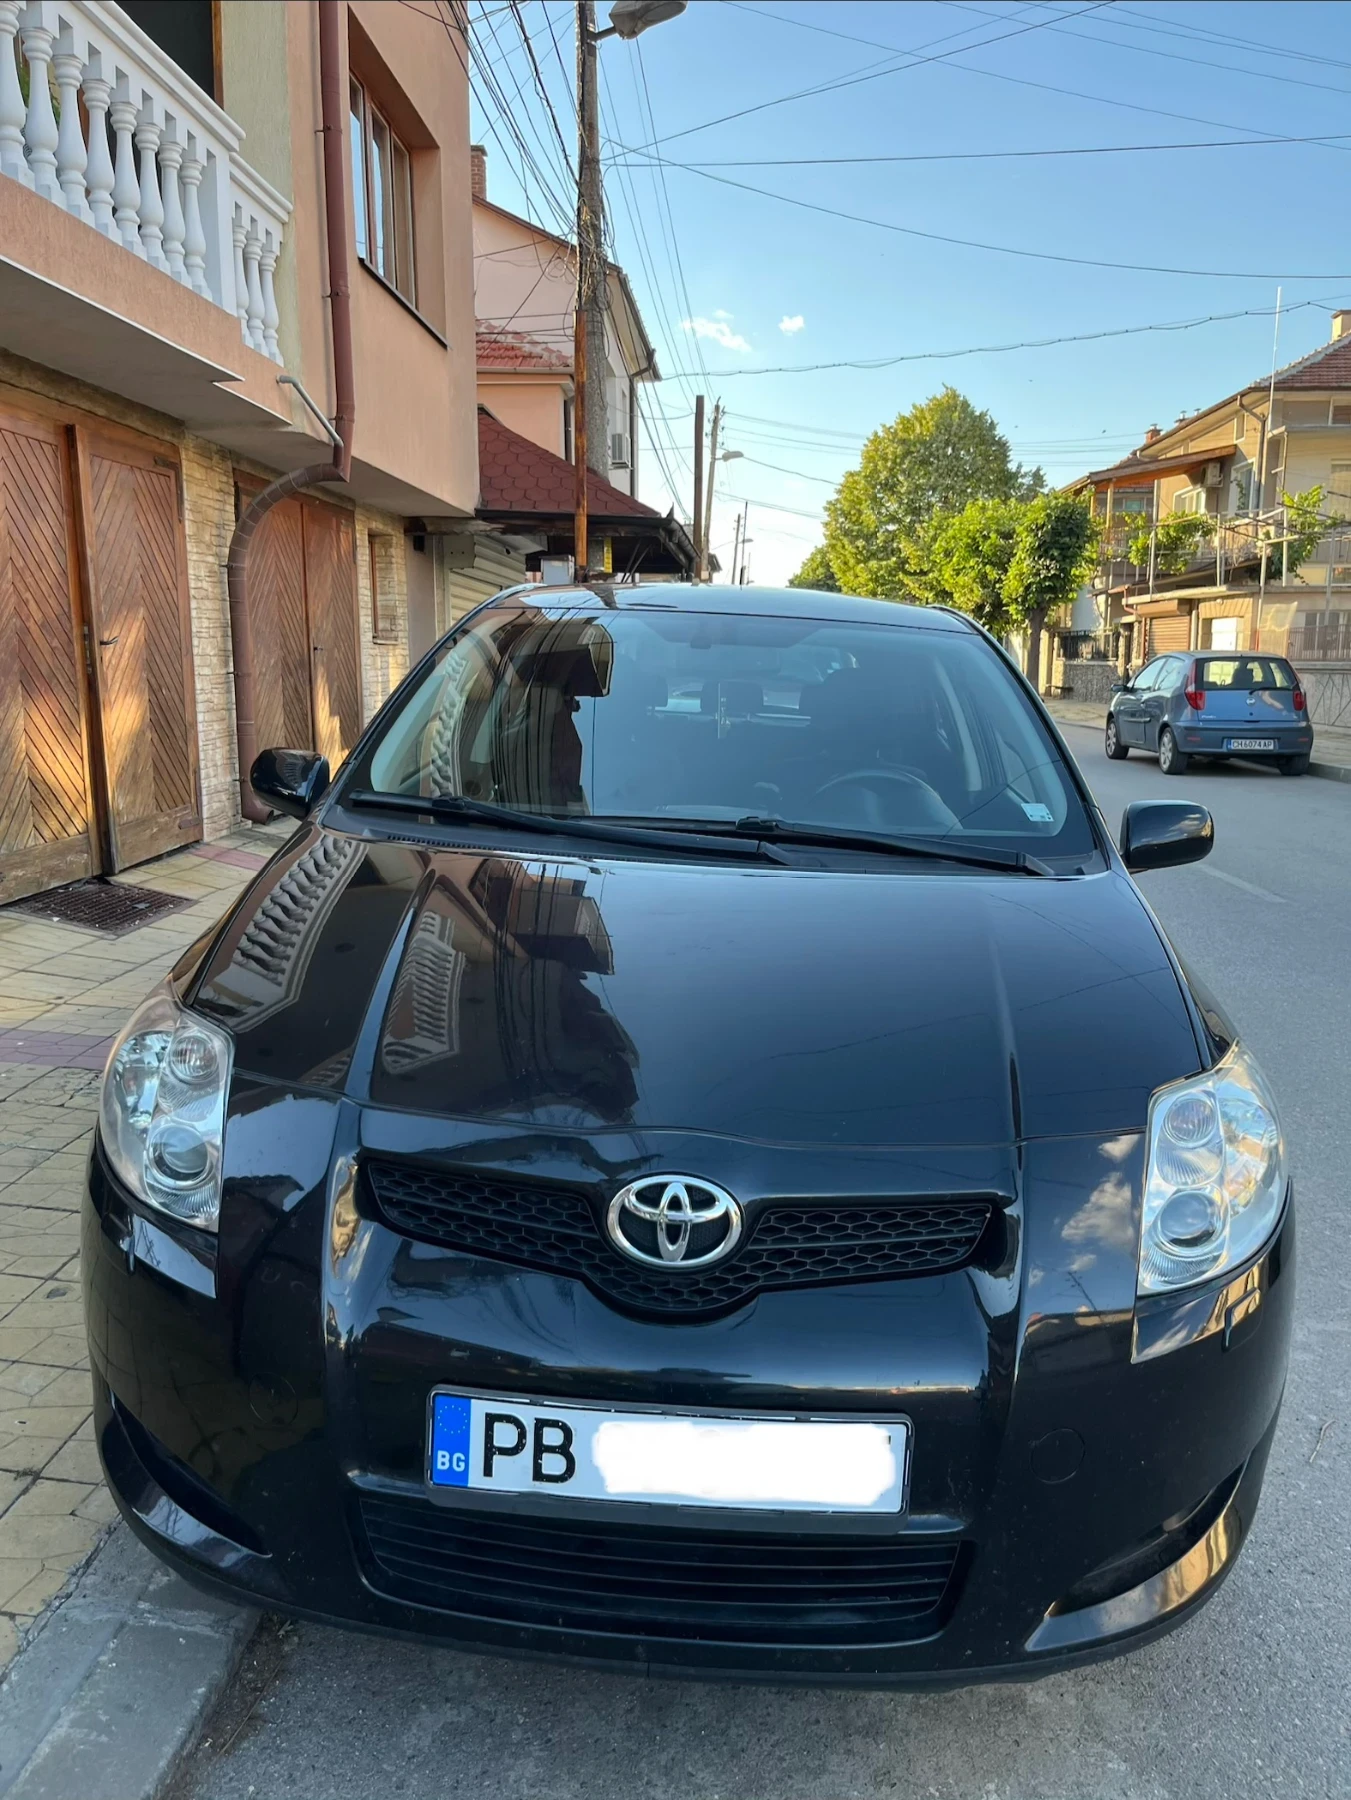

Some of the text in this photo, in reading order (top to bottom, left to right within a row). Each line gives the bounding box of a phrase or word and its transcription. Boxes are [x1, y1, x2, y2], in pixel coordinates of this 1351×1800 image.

[1243, 740, 1262, 749] 6074
[1262, 740, 1273, 749] AP
[483, 1412, 576, 1484] PB
[436, 1450, 466, 1472] BG
